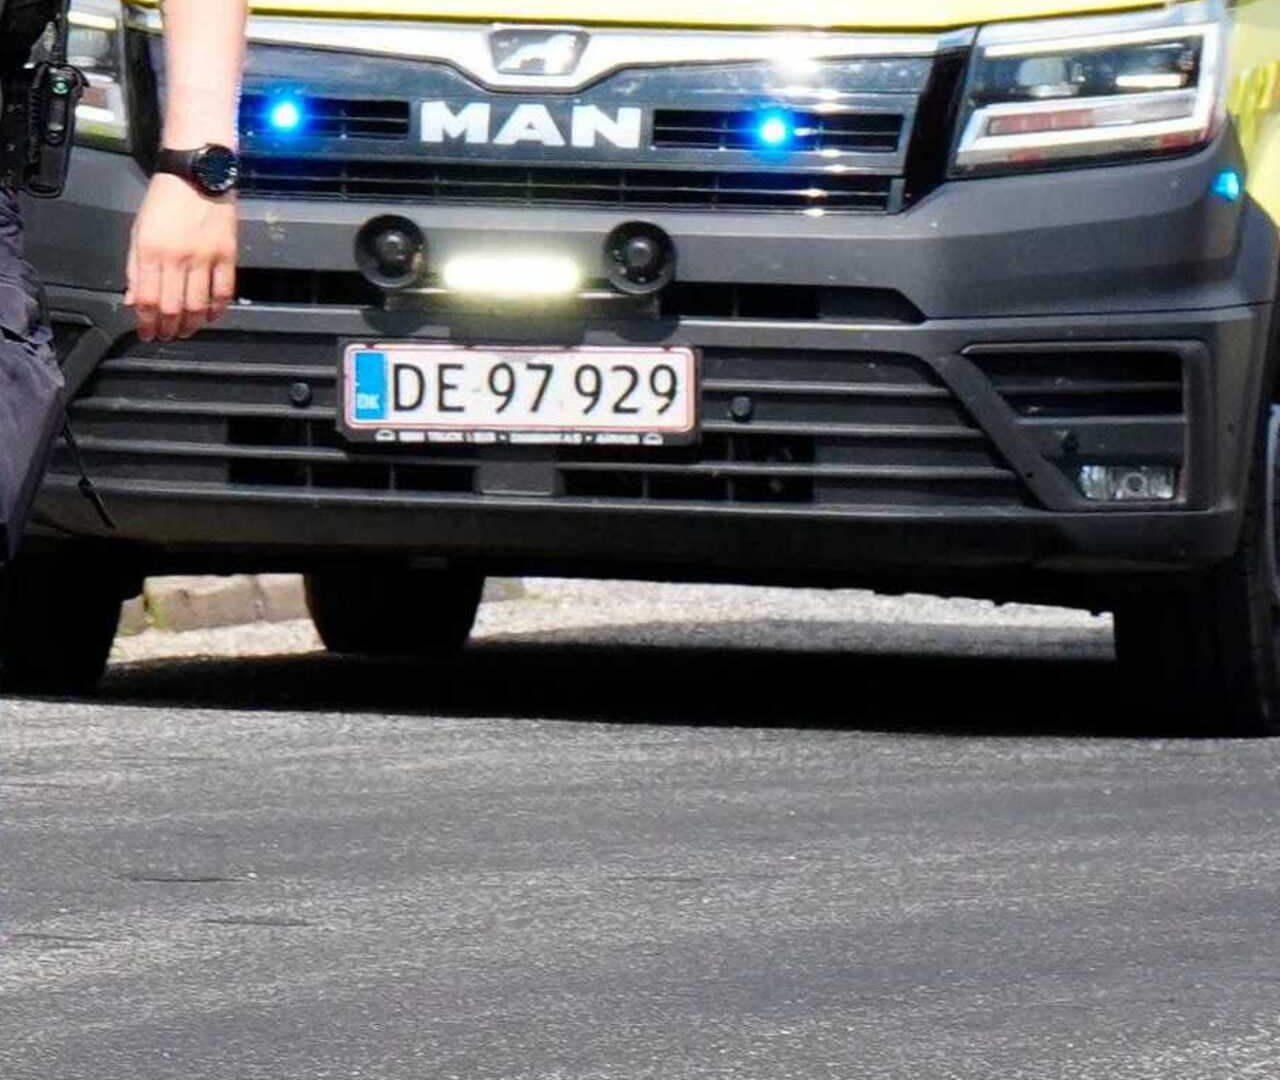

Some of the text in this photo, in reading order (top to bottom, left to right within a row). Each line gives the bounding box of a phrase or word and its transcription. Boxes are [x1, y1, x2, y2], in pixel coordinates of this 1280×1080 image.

[420, 100, 642, 149] MAN
[392, 361, 679, 416] DE 97 929
